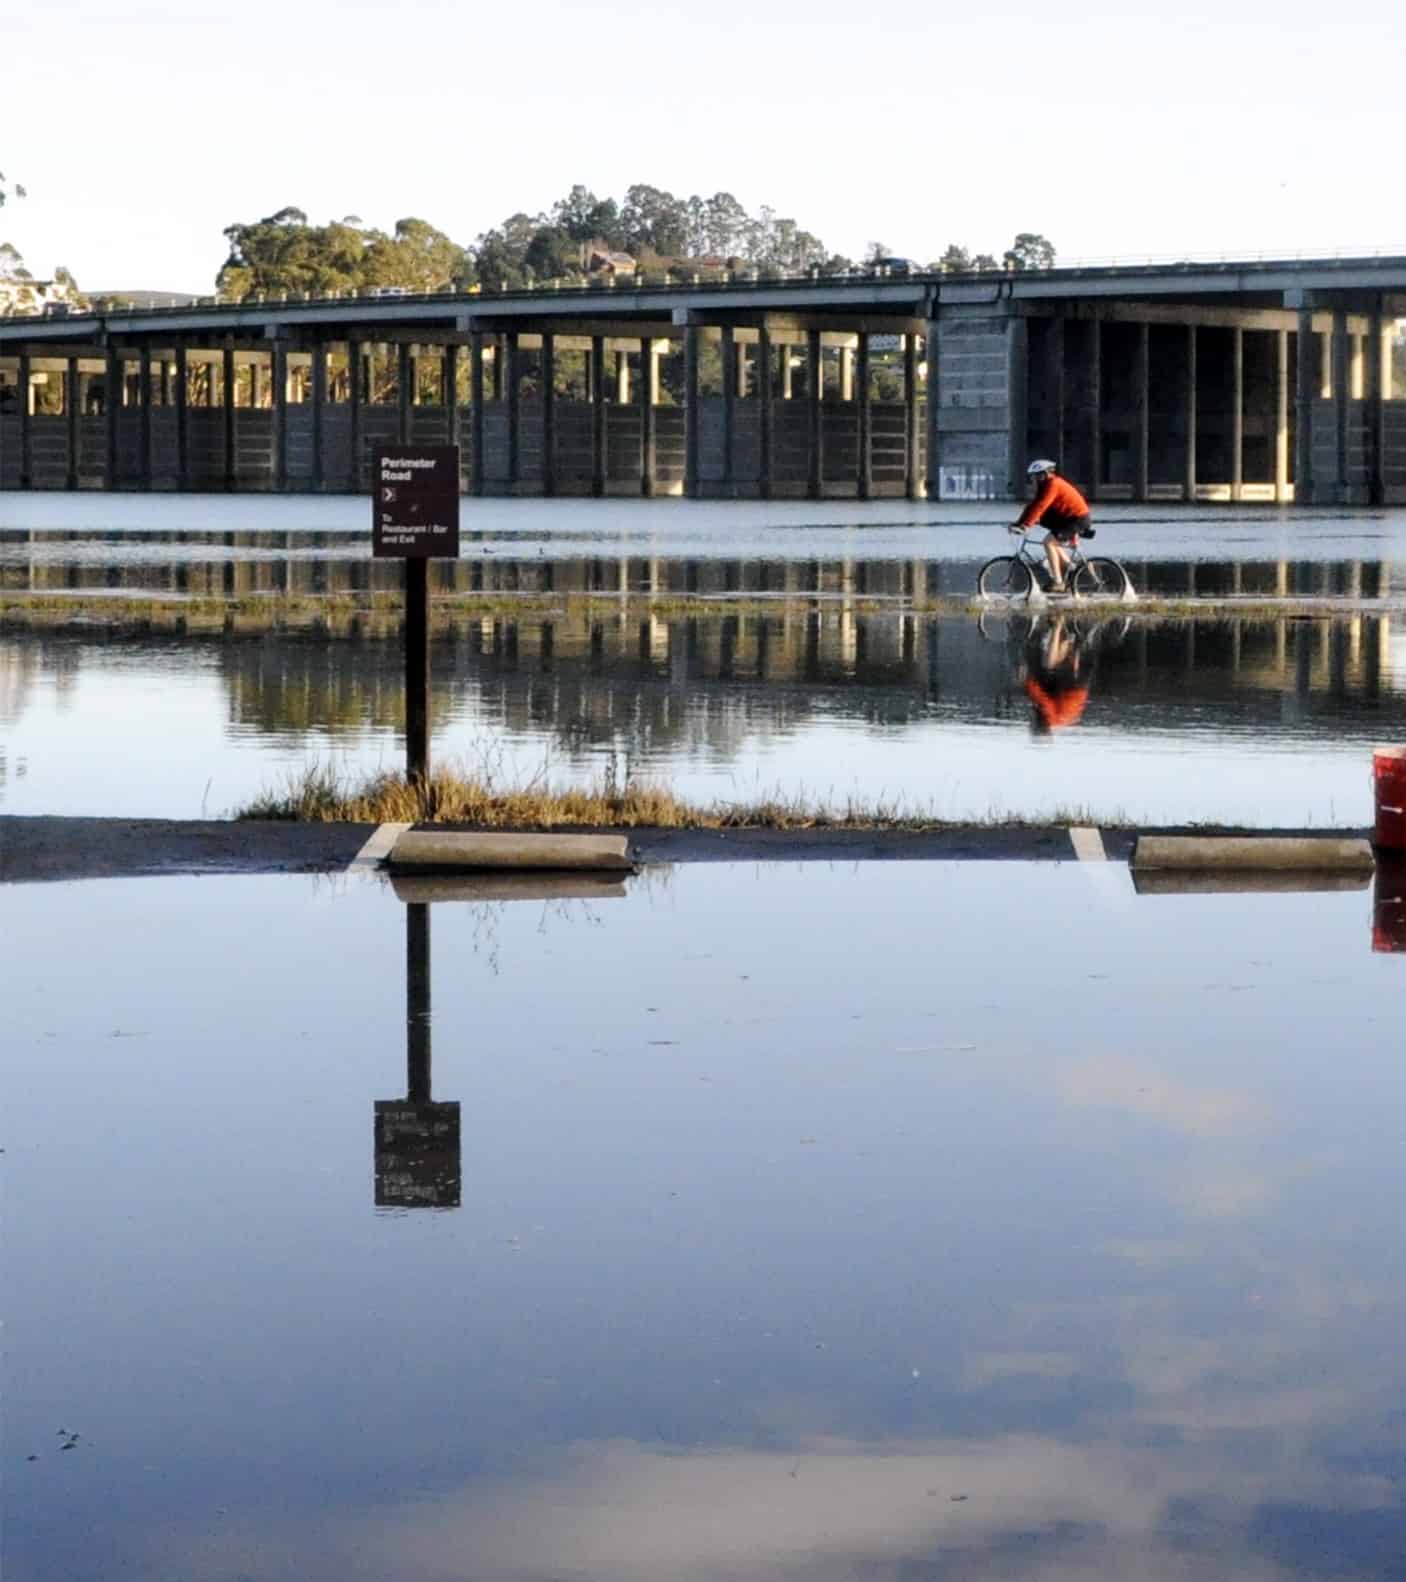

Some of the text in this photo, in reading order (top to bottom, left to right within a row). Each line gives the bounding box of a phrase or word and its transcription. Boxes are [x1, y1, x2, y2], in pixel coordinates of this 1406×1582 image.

[381, 457, 436, 469] Perimeter
[381, 469, 412, 480] Road
[382, 513, 392, 522] To
[381, 524, 426, 533] Restaurant
[433, 524, 448, 533] Bar
[381, 535, 415, 543] and Exit
